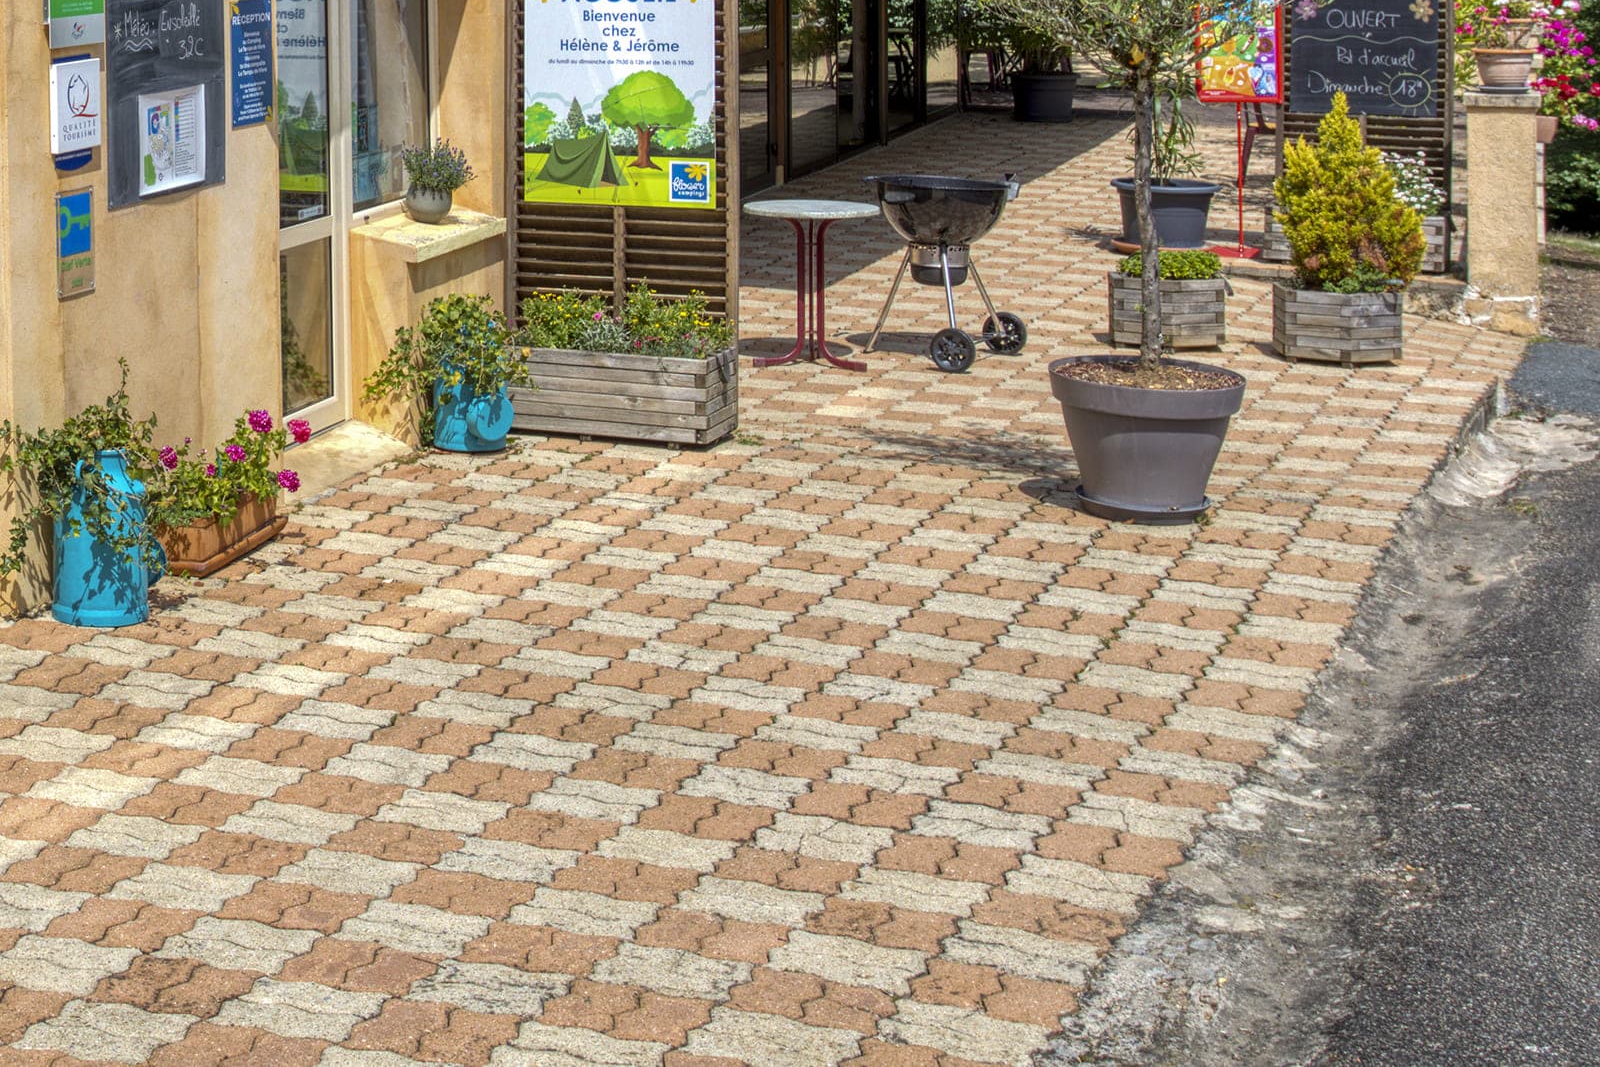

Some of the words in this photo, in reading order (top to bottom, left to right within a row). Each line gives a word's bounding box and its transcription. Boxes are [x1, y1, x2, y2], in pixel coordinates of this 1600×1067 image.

[232, 12, 271, 25] RÉCEPTION
[583, 9, 656, 22] Bienvenue
[1326, 8, 1401, 29] OUVERT
[602, 24, 636, 37] chez
[560, 38, 608, 52] Hélène
[613, 40, 622, 52] &
[627, 38, 680, 52] Jérôme
